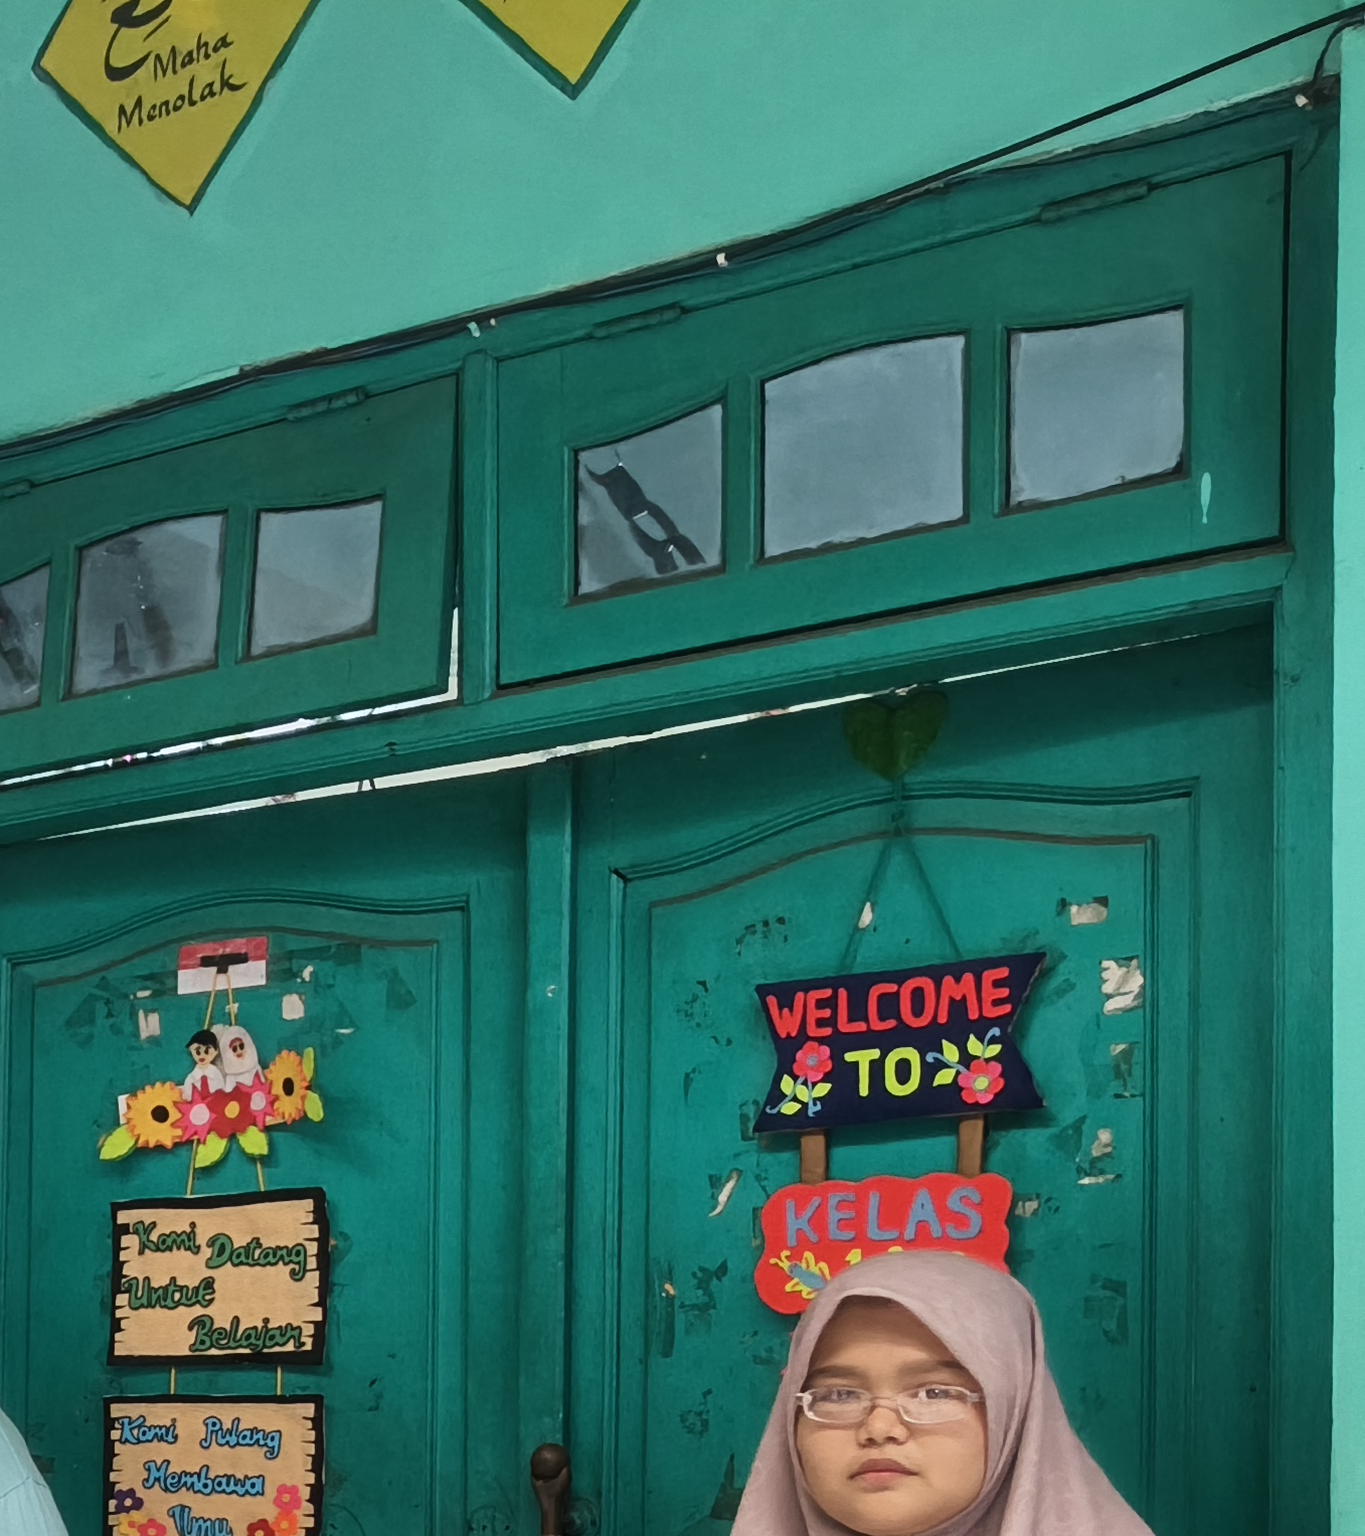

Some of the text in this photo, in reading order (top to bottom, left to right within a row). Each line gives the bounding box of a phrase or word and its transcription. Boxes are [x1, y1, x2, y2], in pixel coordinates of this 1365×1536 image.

[153, 31, 235, 83] Maha
[118, 58, 249, 134] Menolak
[766, 966, 1012, 1038] WELCOME
[843, 1046, 922, 1097] TO
[785, 1186, 985, 1248] KELAS
[133, 1220, 308, 1281] Kami Datang
[123, 1276, 216, 1310] Untuk
[188, 1314, 306, 1353] Belajar
[119, 1415, 282, 1460] Kami Pulang
[142, 1459, 266, 1497] Membawa
